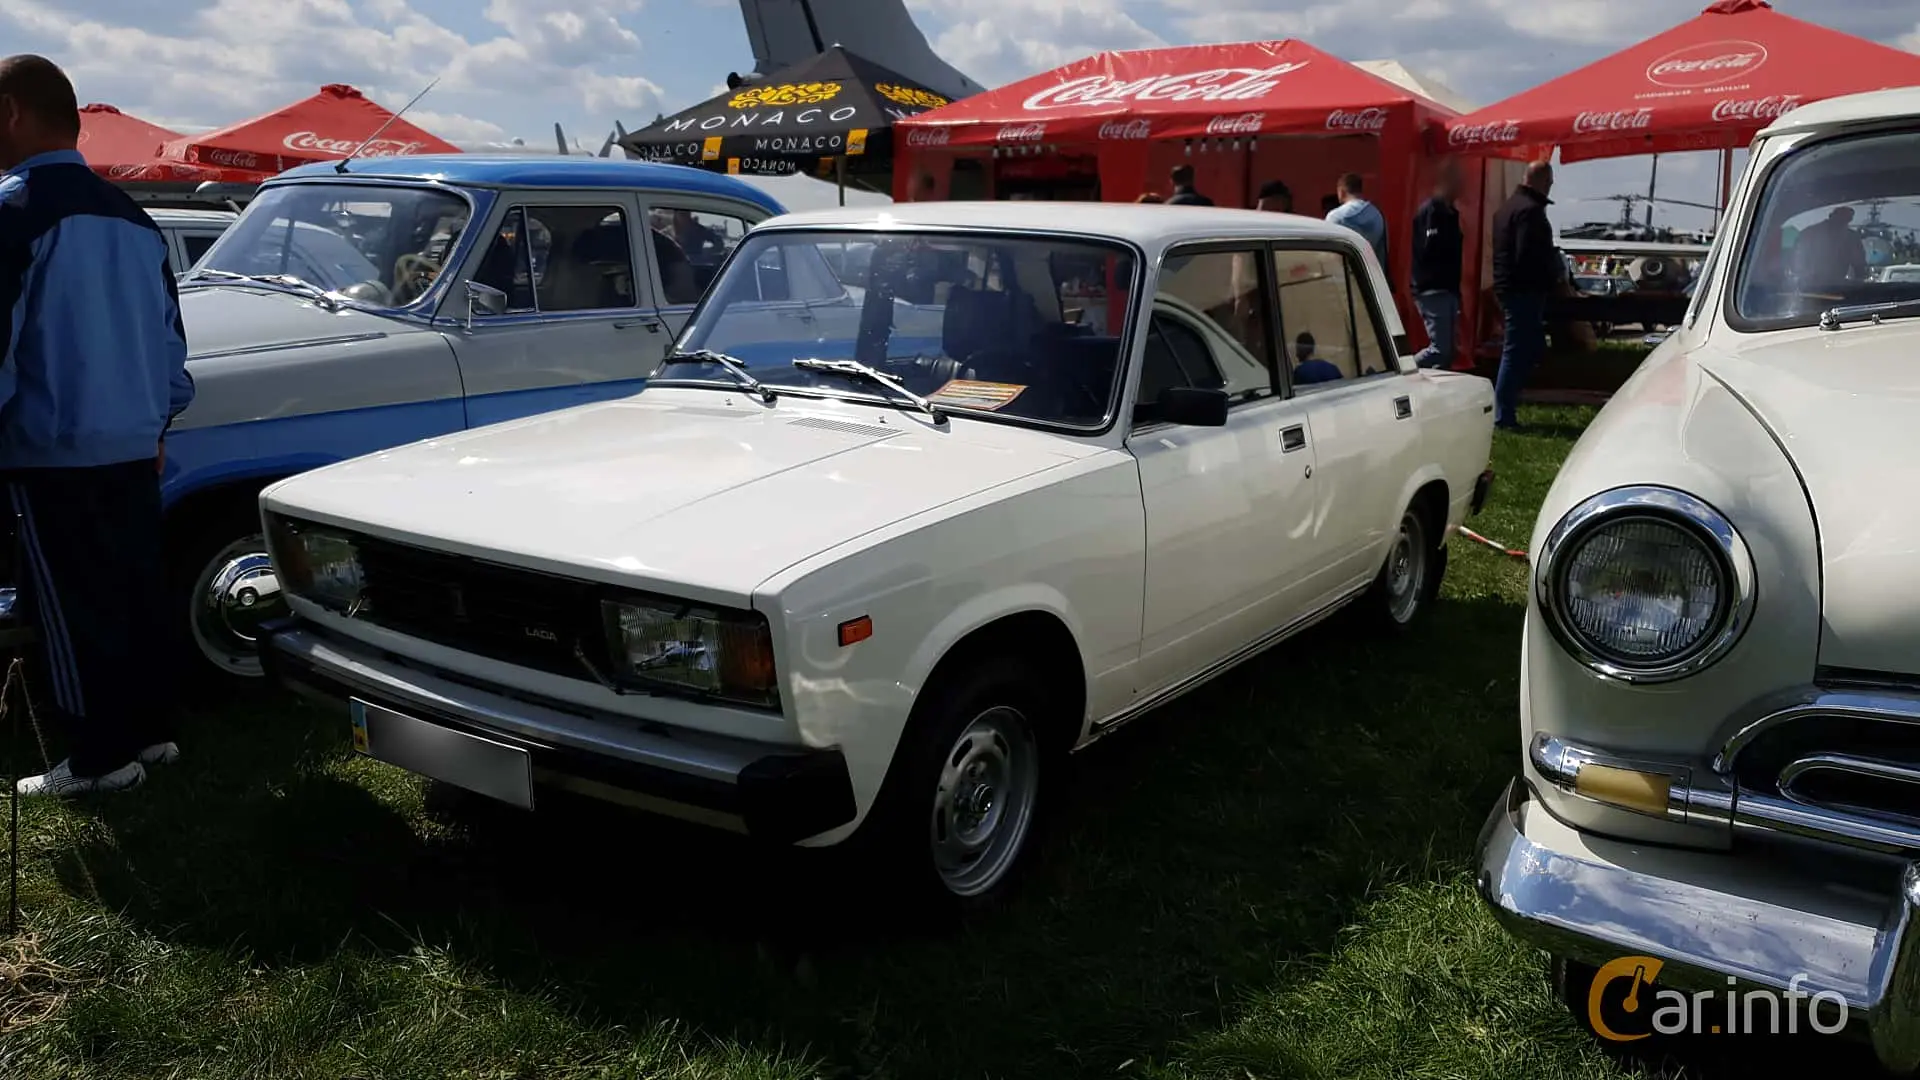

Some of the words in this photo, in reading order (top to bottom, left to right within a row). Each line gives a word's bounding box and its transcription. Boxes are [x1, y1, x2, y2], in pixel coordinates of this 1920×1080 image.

[1022, 60, 1311, 110] Coca-Cola
[664, 106, 857, 132] MONACO
[1326, 106, 1388, 130] Coca-Cola
[1573, 107, 1654, 134] Coca-Cola
[754, 135, 842, 151] MONACO
[1448, 119, 1522, 146] Coca-Cola
[210, 149, 257, 169] Coca-Cola
[525, 626, 558, 641] LADA
